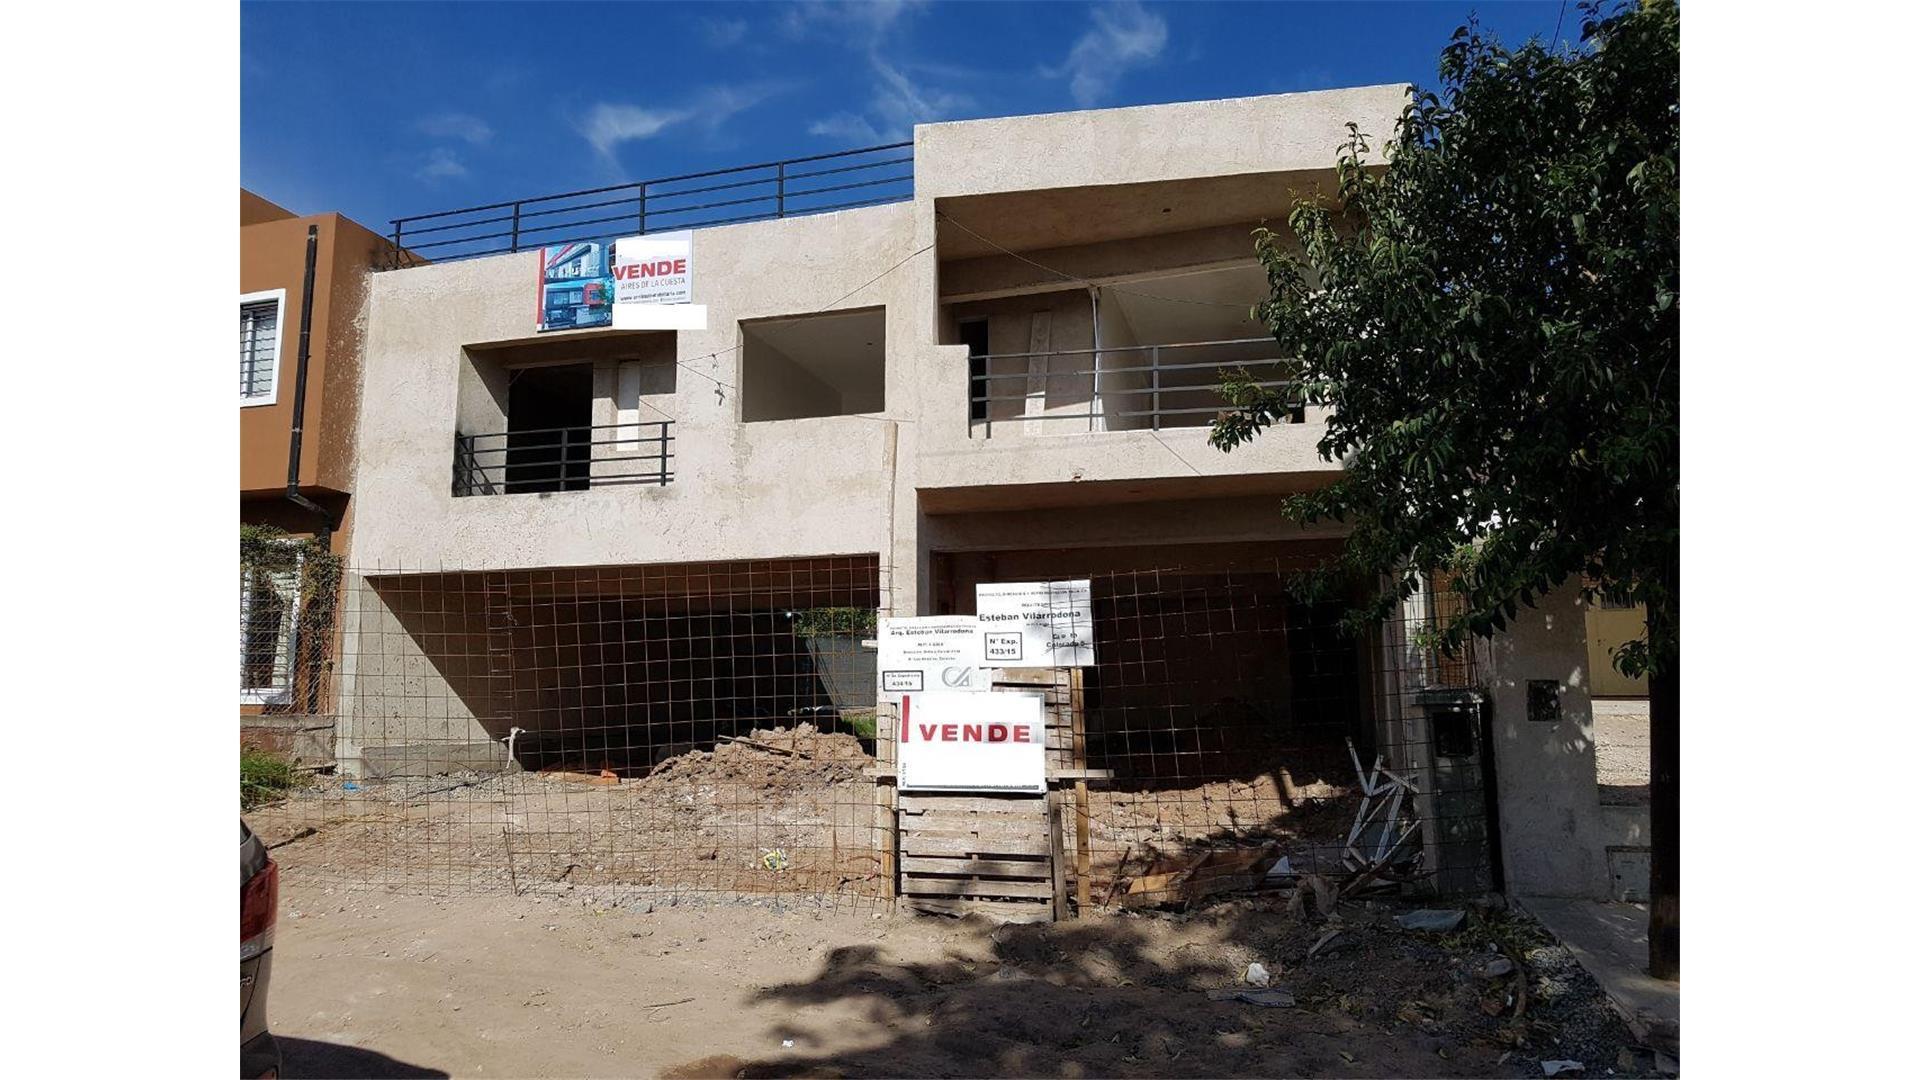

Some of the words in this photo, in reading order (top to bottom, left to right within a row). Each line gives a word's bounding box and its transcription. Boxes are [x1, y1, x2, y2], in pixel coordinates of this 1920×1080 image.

[613, 259, 686, 280] VENDE
[621, 281, 641, 290] AIRES
[660, 277, 686, 287] CUESTA
[979, 613, 1019, 622] Esteban
[1022, 611, 1081, 620] Vilarrodona
[1001, 638, 1018, 646] Exp.
[919, 723, 1031, 743] VENDE
